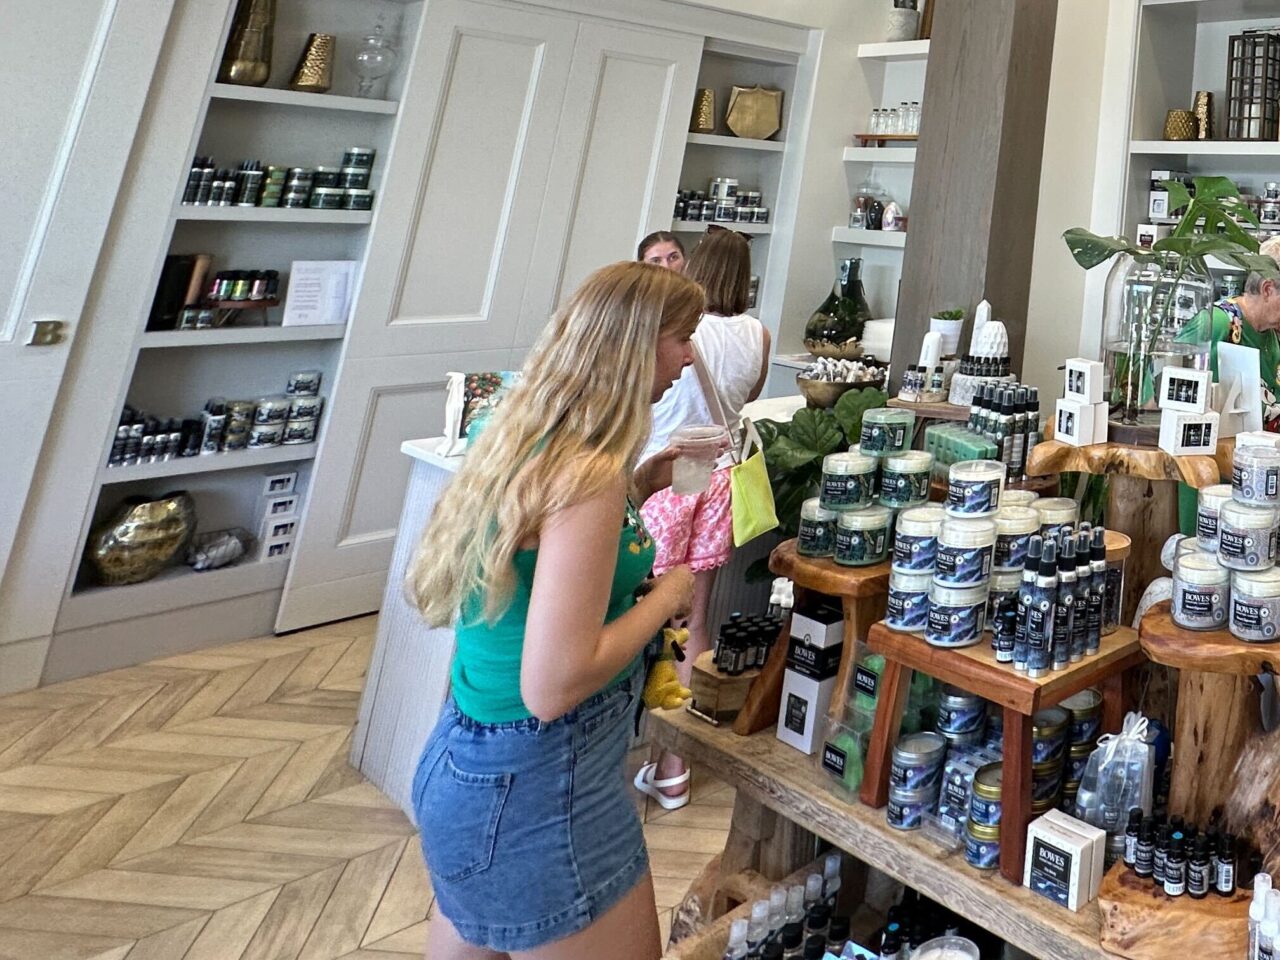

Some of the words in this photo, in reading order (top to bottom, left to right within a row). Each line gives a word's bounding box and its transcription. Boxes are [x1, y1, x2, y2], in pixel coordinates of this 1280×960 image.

[1222, 533, 1243, 544] BOWES
[1185, 592, 1210, 602] BOWES
[1236, 603, 1259, 615] BOWES
[794, 645, 816, 661] BOWES
[857, 672, 875, 687] BOWES
[1039, 846, 1065, 867] BOWES
